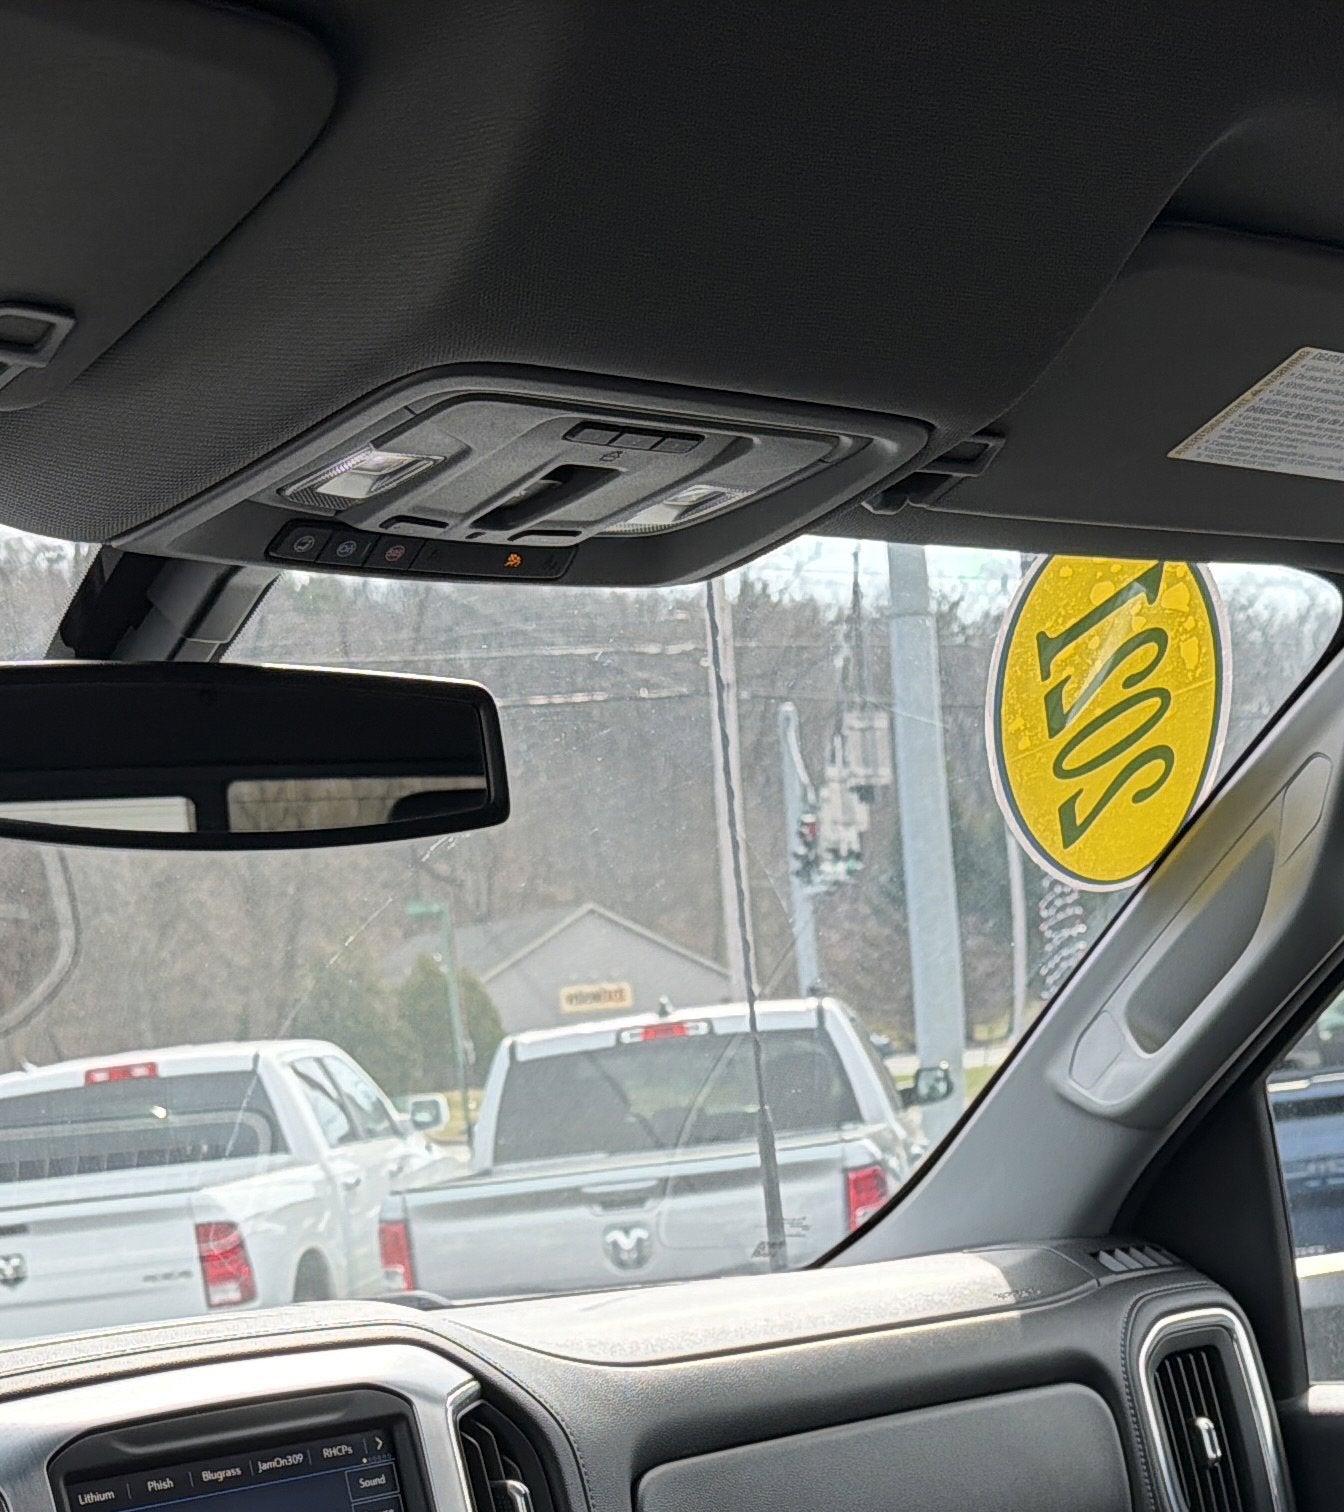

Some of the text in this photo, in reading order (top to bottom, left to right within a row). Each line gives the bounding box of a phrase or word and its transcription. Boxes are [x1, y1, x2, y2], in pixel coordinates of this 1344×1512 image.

[323, 1445, 353, 1459] RHCPs
[258, 1453, 304, 1473] JamOn309
[202, 1467, 242, 1482] Blugrass
[359, 1474, 386, 1489] Sound
[147, 1478, 174, 1492] Phish
[78, 1490, 115, 1505] Lithium
